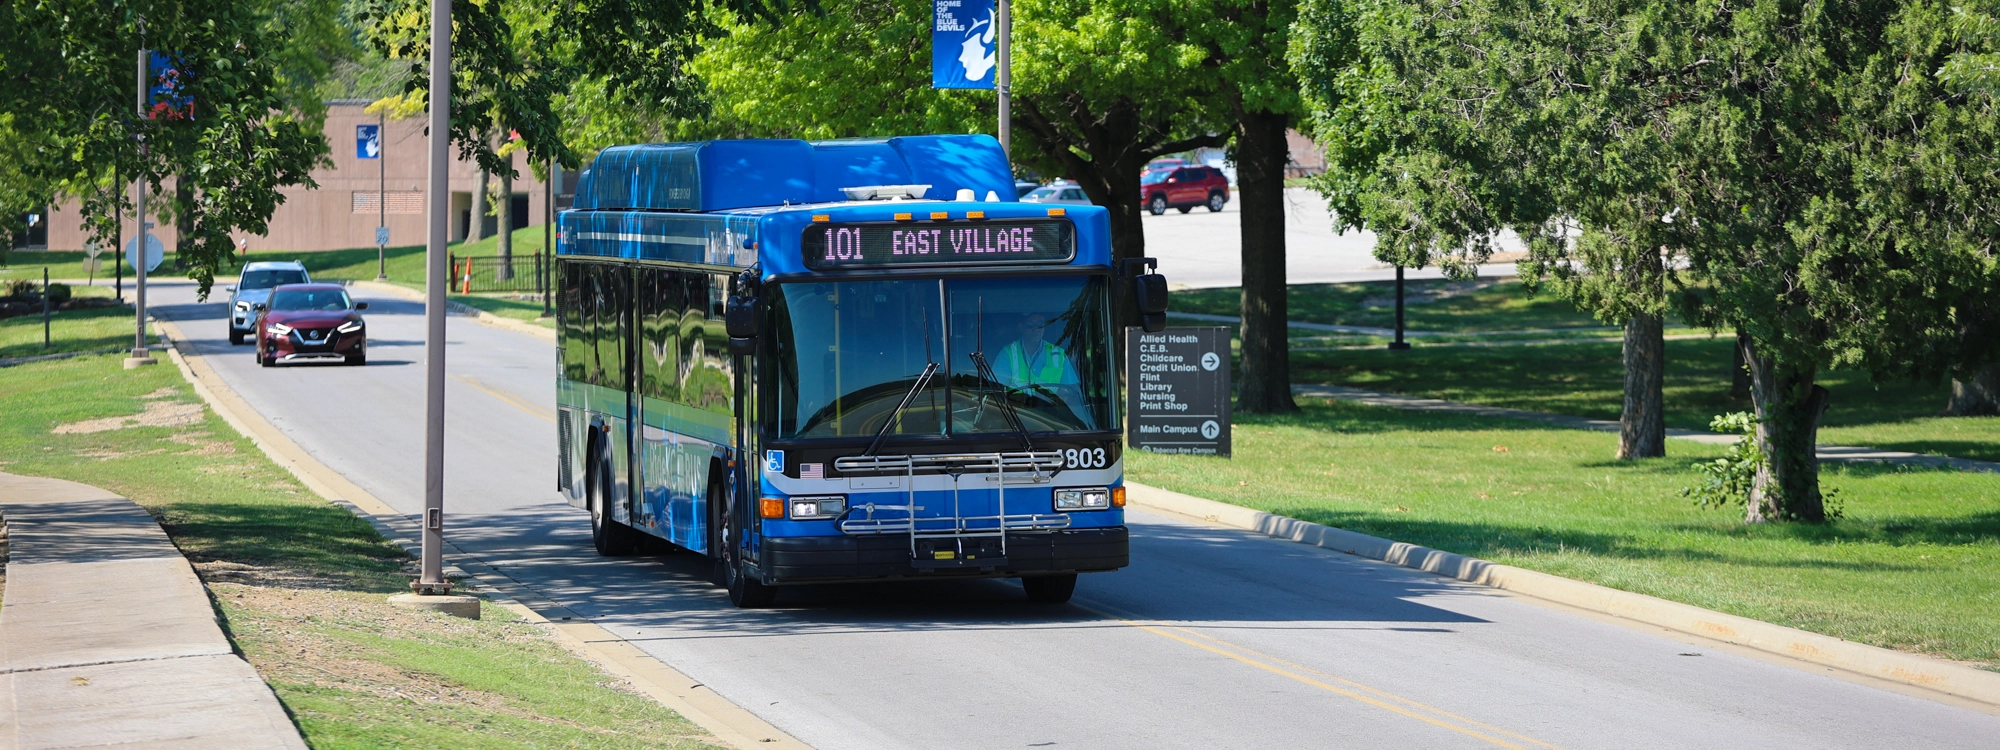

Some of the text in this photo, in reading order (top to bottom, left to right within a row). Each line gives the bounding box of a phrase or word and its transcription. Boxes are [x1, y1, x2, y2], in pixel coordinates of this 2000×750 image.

[824, 227, 1034, 260] 101 EAST VILLAGE
[1140, 335, 1198, 343] Allied Health
[1140, 344, 1168, 352] C.E.B.
[1140, 354, 1184, 362] Childcare
[1140, 364, 1197, 372] Credit Union
[1140, 373, 1160, 381] Flint
[1140, 383, 1172, 392] Library
[1140, 392, 1176, 402] Nursing
[1140, 402, 1188, 411] Print Shop
[1140, 425, 1198, 435] Main Campus
[684, 452, 702, 498] BUS
